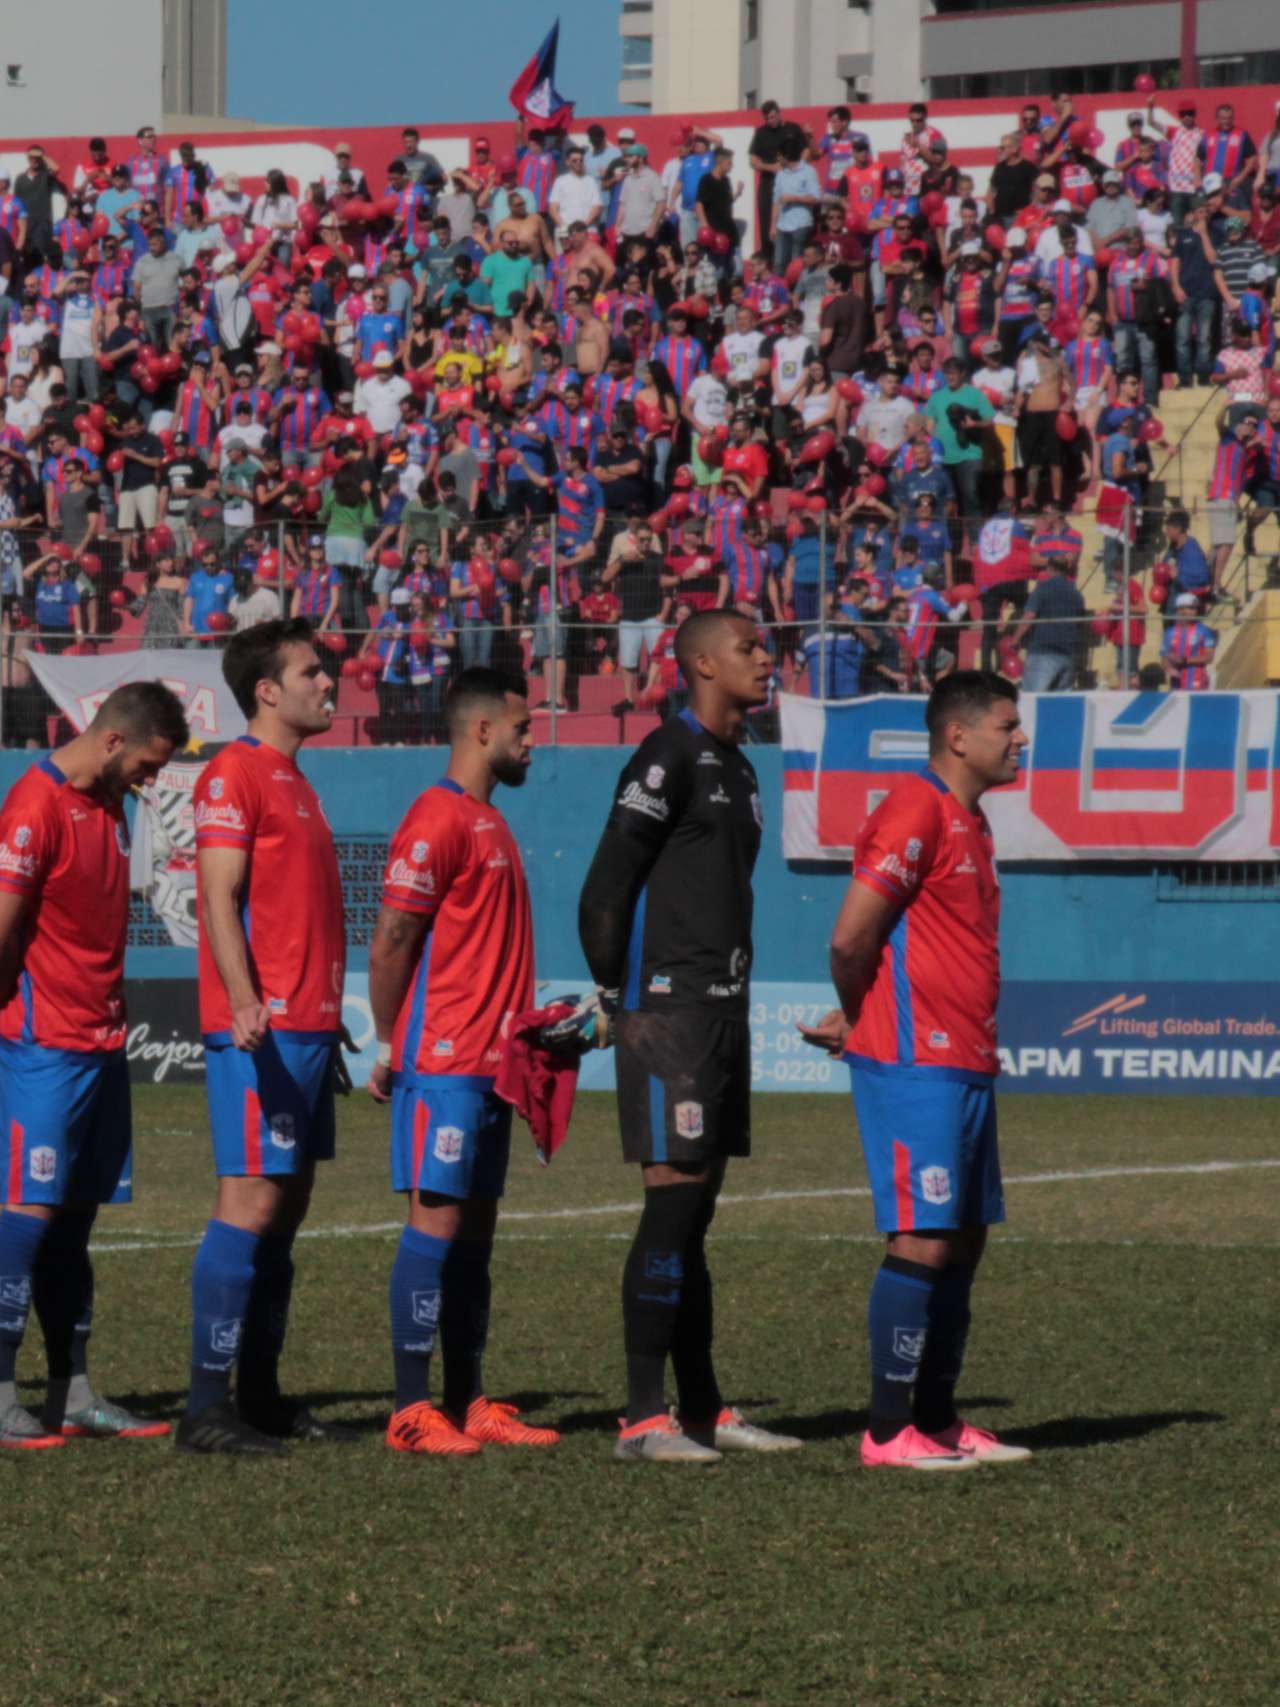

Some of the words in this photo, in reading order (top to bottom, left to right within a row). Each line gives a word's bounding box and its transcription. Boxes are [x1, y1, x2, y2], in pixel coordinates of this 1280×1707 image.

[1100, 1017, 1158, 1038] Lifting
[1163, 1018, 1220, 1035] Global
[997, 1048, 1081, 1077] APM
